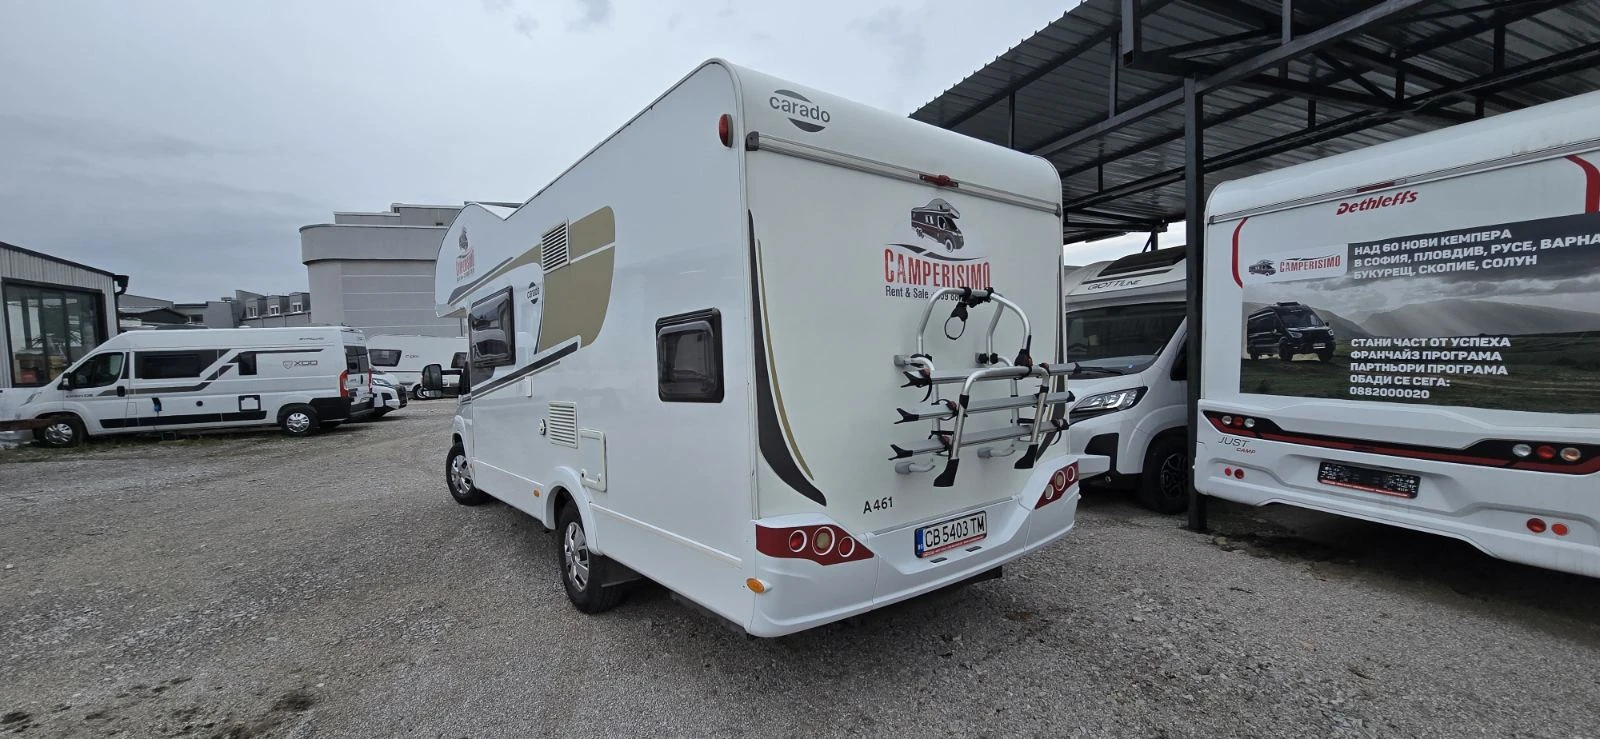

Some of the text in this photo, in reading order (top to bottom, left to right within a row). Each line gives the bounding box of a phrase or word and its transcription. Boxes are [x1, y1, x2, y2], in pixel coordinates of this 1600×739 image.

[769, 96, 830, 123] carado
[1336, 190, 1419, 215] Dethleffs
[1354, 228, 1512, 256] НАД 60 НОВИ КЕМПЕРА
[1354, 234, 1600, 268] В СОФИЯ, ПЛОВДИВ, РУСЕ, ВАРНА
[884, 248, 990, 291] CAMPERISIMO
[1280, 255, 1341, 272] CAMPERISIMO
[1354, 254, 1537, 280] БУКУРЕЩ, СКОПИЕ, СОЛУН
[886, 285, 903, 297] Rent
[905, 287, 910, 298] &
[913, 287, 929, 299] Sale
[1351, 337, 1511, 347] СТАНИ ЧАСТ ОТ УСПЕХА
[1350, 349, 1502, 361] ФРАНЧАЙЗ ПРОГРАМА
[1350, 362, 1508, 375] ПАРТНЬОРИ ПРОГРАМА
[1350, 374, 1450, 387] ОБАДИ СЕ СЕГА:
[1350, 386, 1430, 399] 0882000020
[1217, 436, 1251, 448] JUST
[863, 496, 893, 514] A 461
[925, 529, 941, 548] CB
[942, 520, 969, 543] 5403
[970, 515, 985, 533] TM
